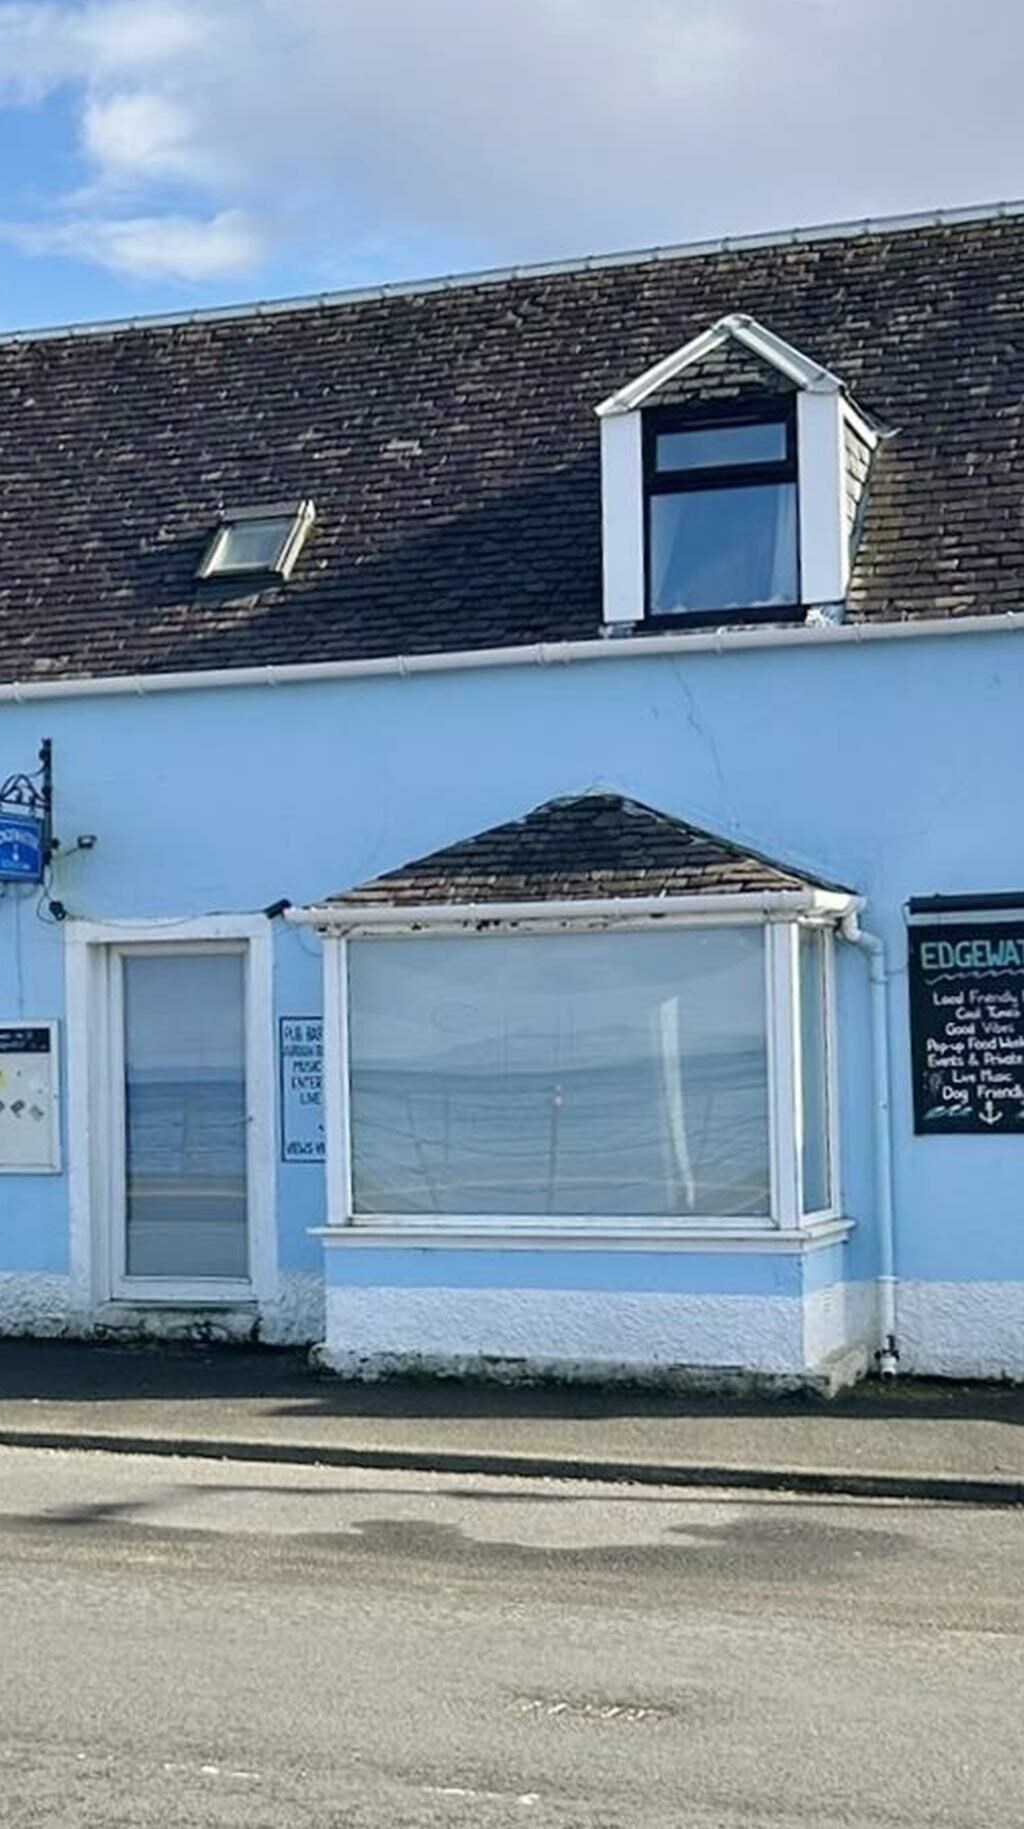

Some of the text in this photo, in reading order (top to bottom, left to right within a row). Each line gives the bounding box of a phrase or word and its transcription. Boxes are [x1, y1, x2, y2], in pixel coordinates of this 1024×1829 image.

[945, 1022, 975, 1036] Good
[968, 1036, 996, 1050] Food
[928, 1053, 964, 1068] Events
[952, 1069, 1014, 1083] Live Music
[943, 1085, 969, 1105] Dog
